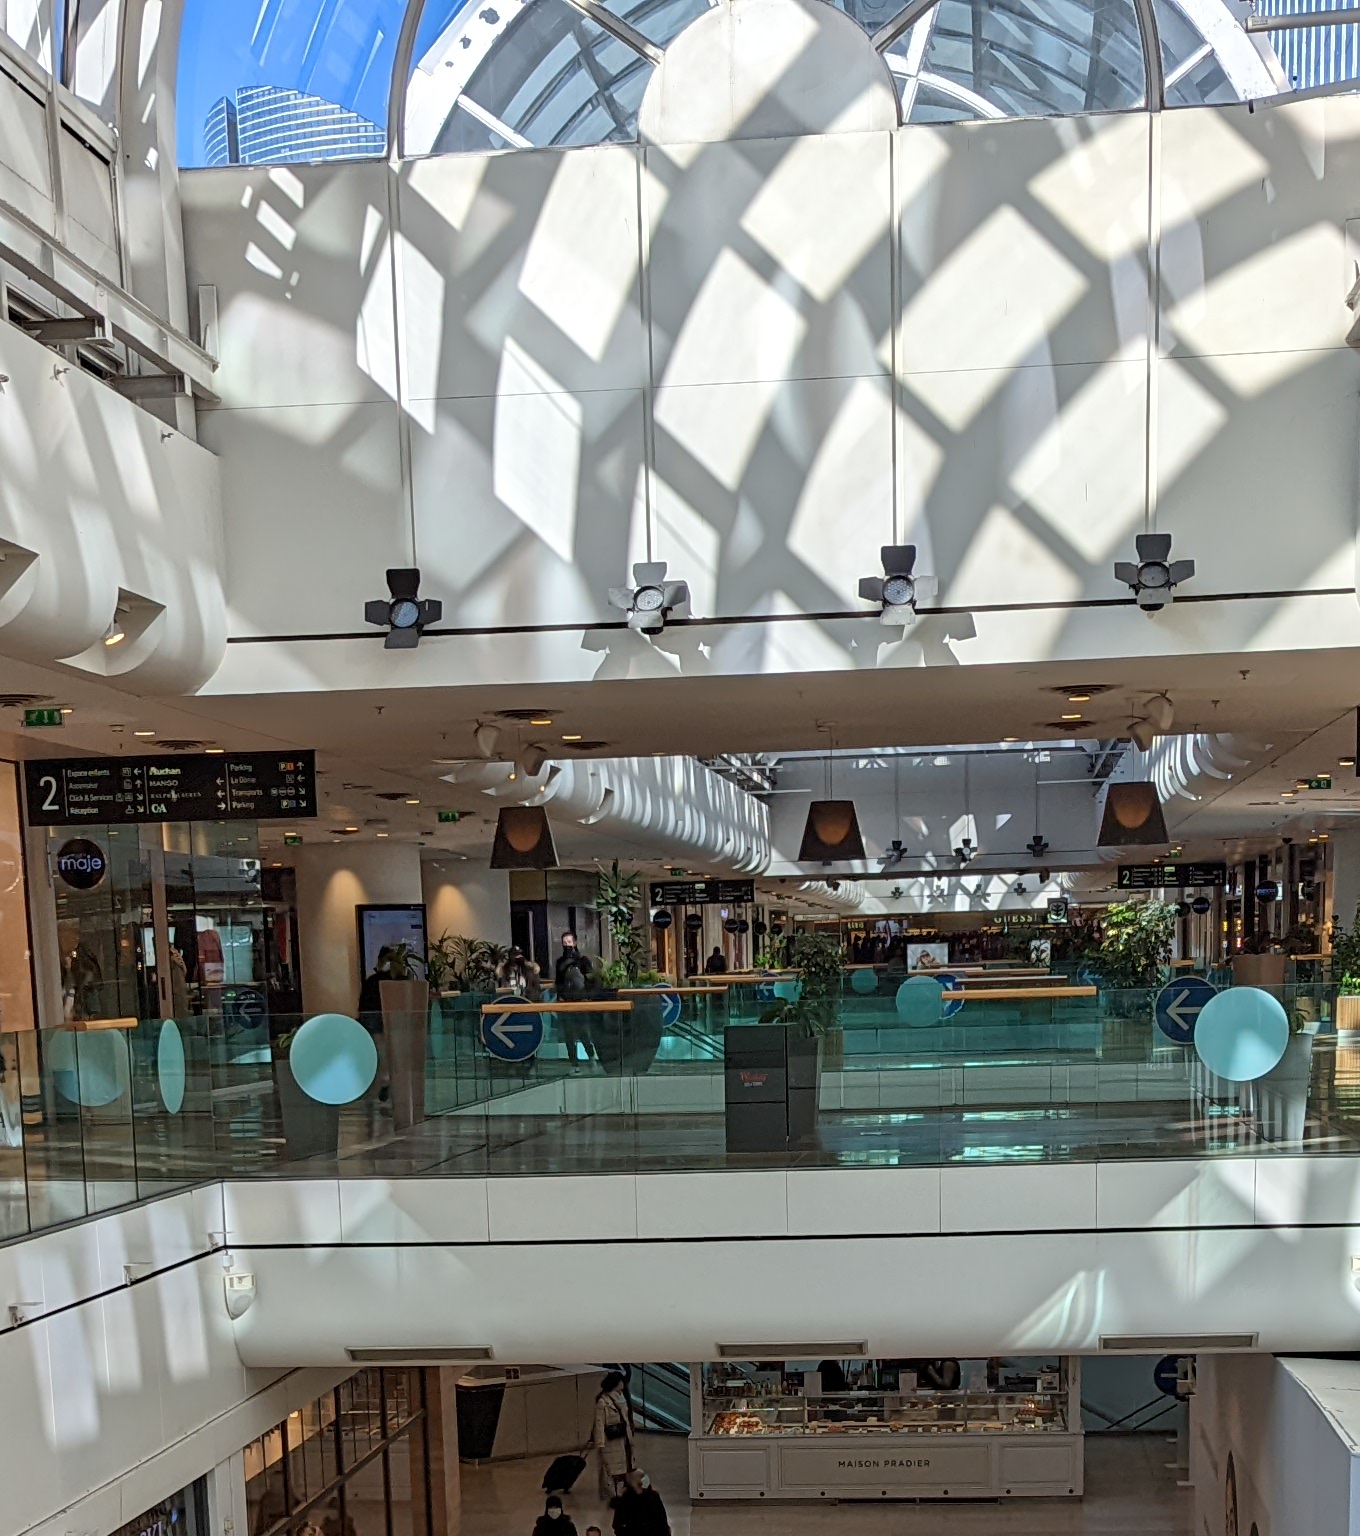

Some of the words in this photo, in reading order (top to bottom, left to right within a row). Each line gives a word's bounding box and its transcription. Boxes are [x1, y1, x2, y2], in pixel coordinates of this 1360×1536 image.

[149, 766, 181, 776] Auchan
[230, 763, 252, 773] Parking
[39, 776, 60, 811] 2
[61, 854, 102, 872] maje
[1123, 870, 1130, 885] 2
[655, 887, 663, 901] 2
[837, 1460, 879, 1468] MAISON
[884, 1459, 931, 1468] PRADIER
